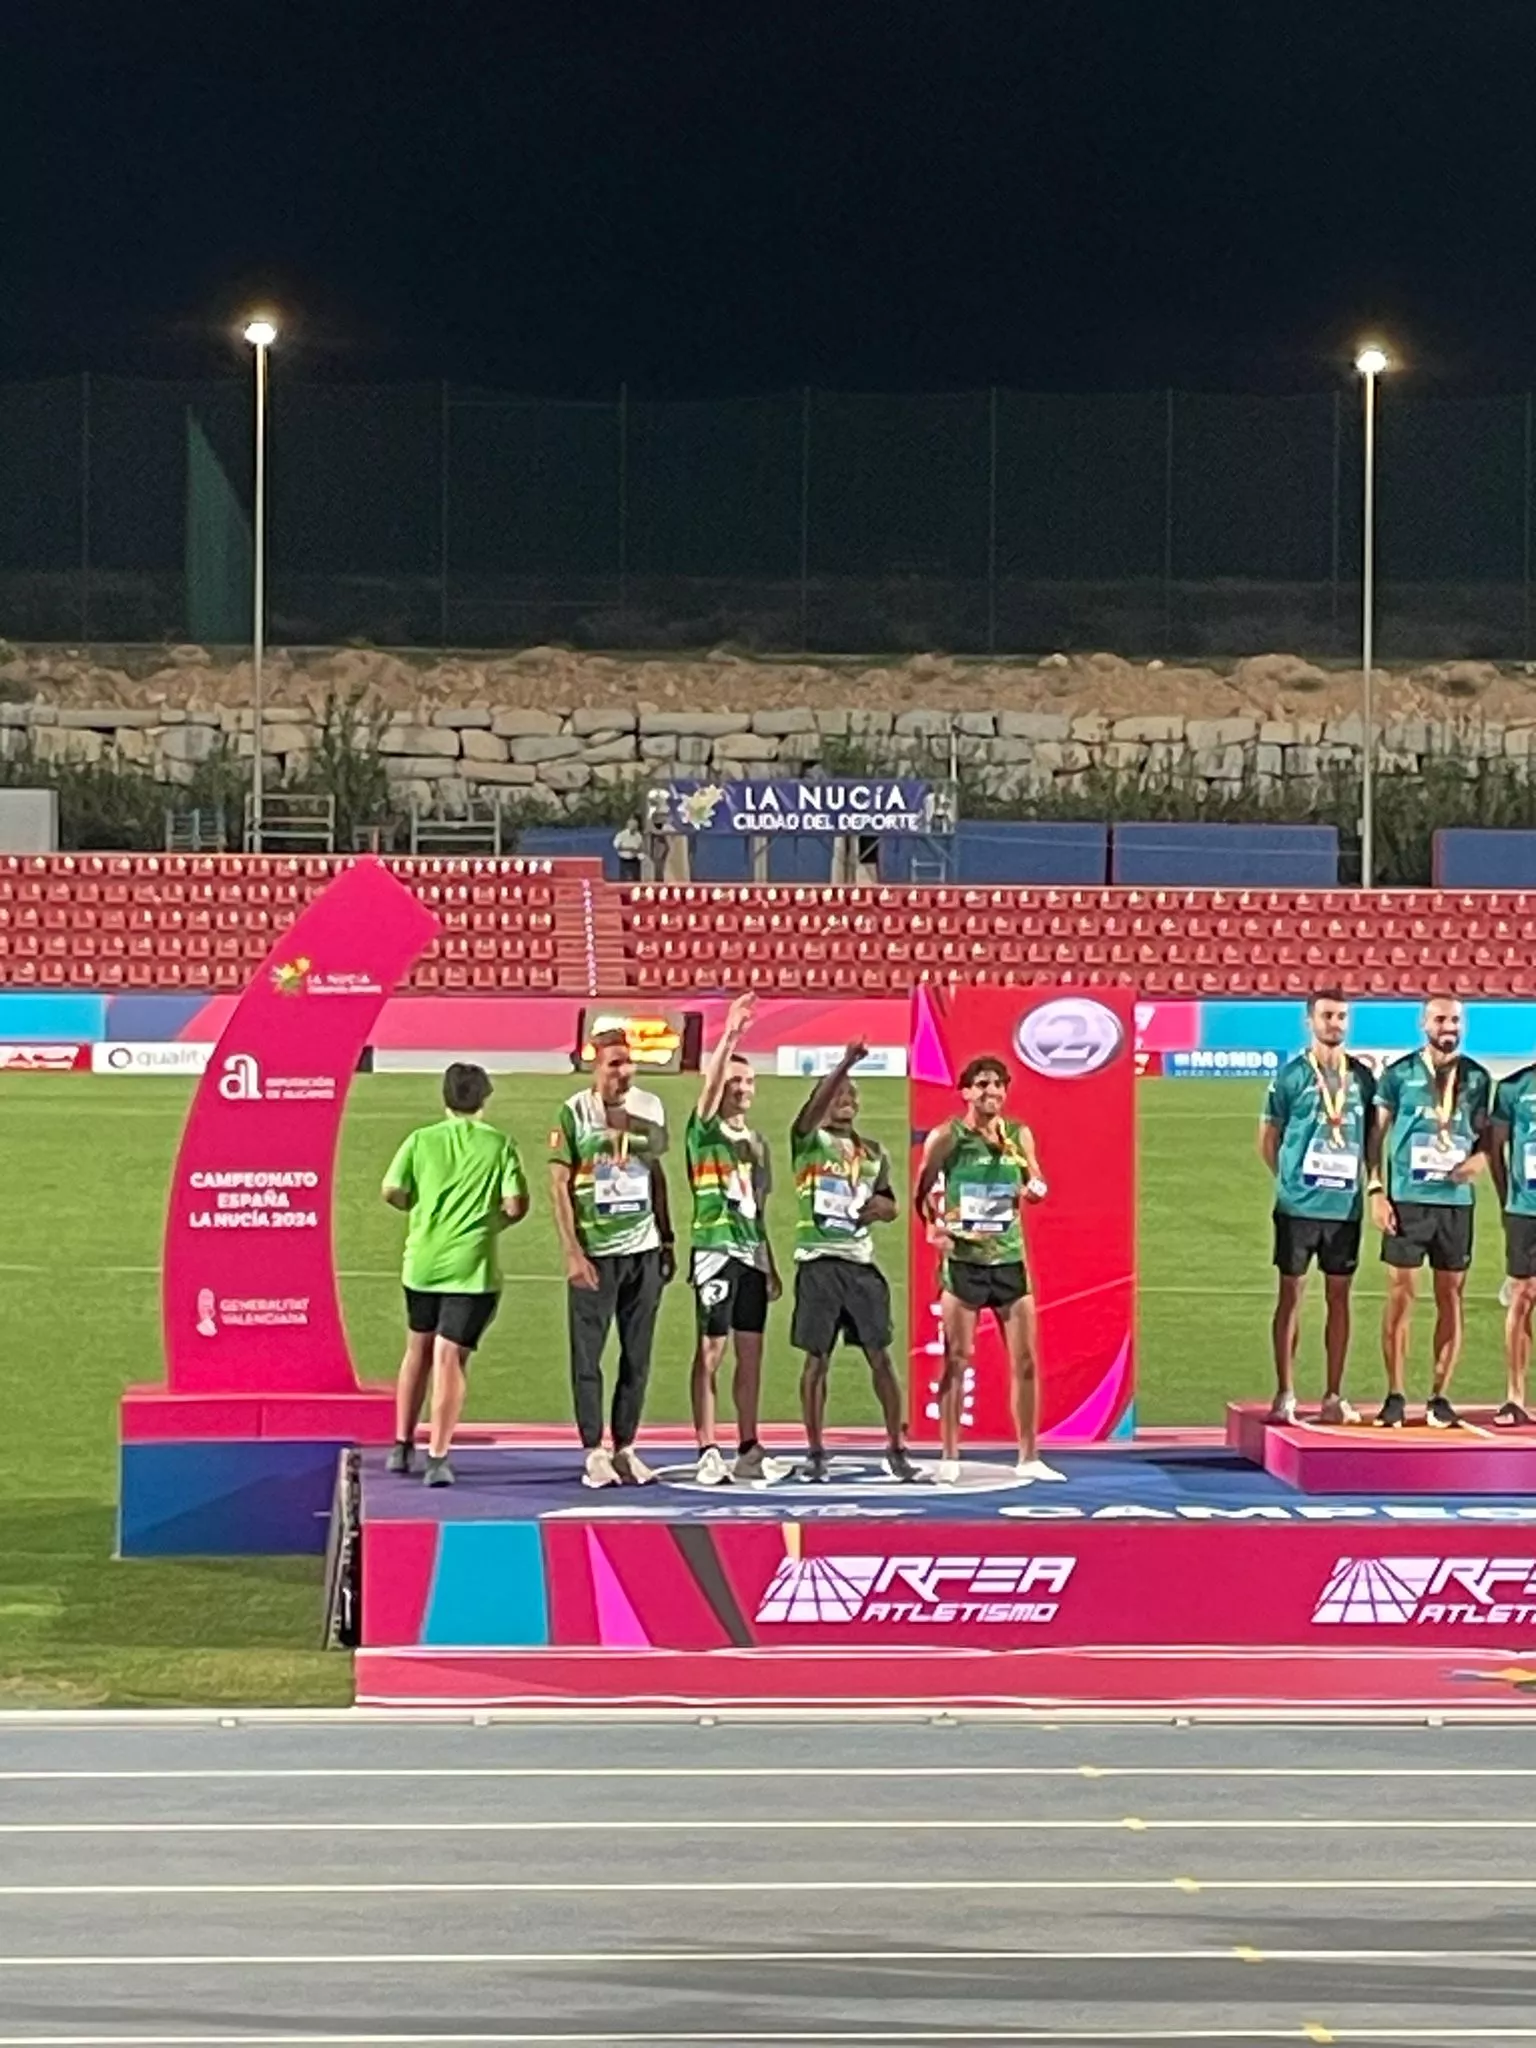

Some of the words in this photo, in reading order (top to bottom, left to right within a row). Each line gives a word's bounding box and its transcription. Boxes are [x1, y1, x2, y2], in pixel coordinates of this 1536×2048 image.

[746, 786, 779, 810] LA
[733, 813, 799, 830] CIUDAD
[803, 814, 835, 830] DEL
[839, 814, 919, 830] DEPORTE
[1047, 1014, 1090, 1059] 2
[1190, 1051, 1278, 1068] MONDO
[189, 1171, 319, 1188] CAMPEONATO
[216, 1188, 290, 1208] ESPAÑA
[189, 1212, 212, 1228] LA
[213, 1208, 269, 1228] NUCÍA
[271, 1211, 318, 1228] 2024
[873, 1556, 1077, 1602] RFEA
[861, 1602, 1060, 1623] ATLETISMO
